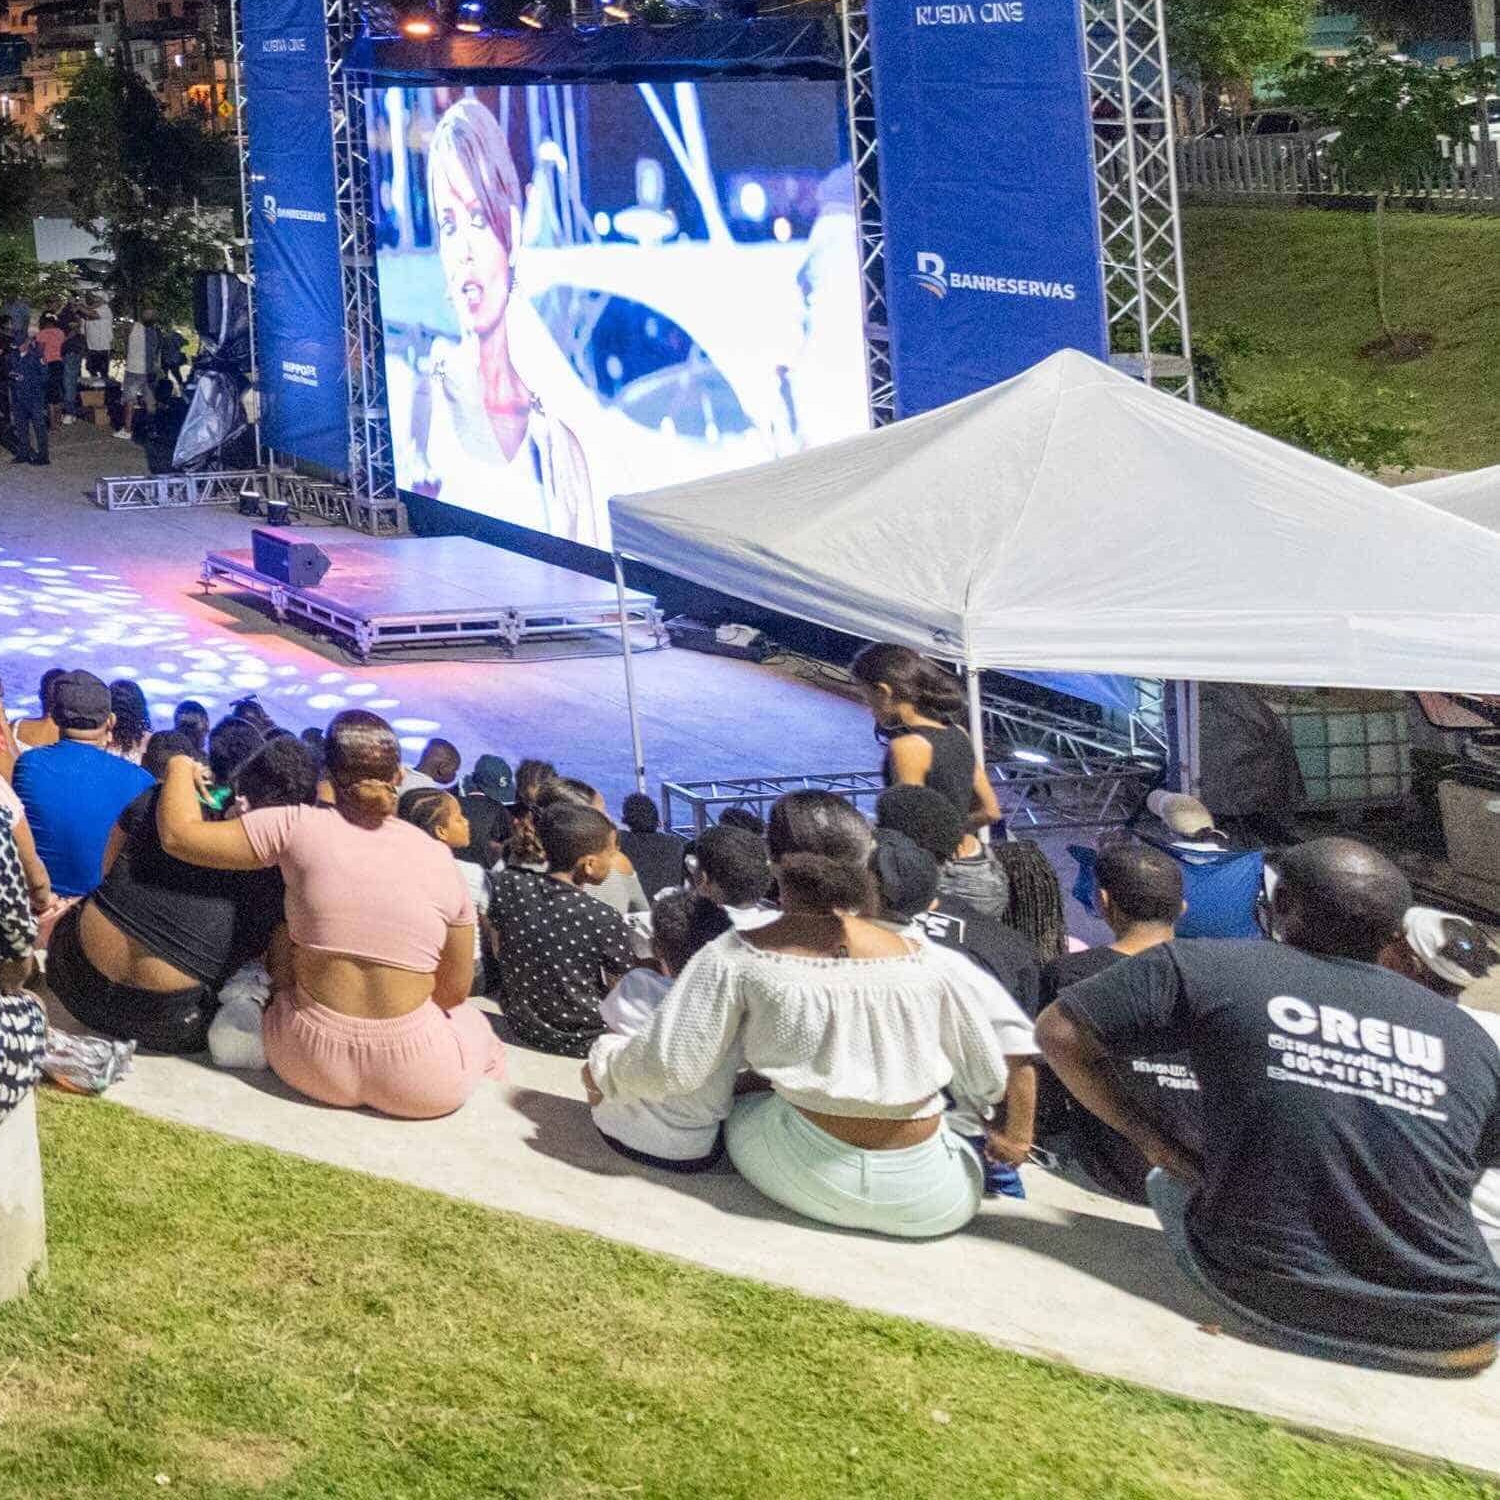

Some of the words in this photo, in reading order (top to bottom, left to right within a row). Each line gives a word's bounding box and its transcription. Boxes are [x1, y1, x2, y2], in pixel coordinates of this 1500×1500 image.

[916, 4, 976, 25] RUEDA
[980, 1, 1024, 23] CINE
[950, 272, 1076, 300] BANRESERVAS
[1267, 996, 1445, 1073] CREW
